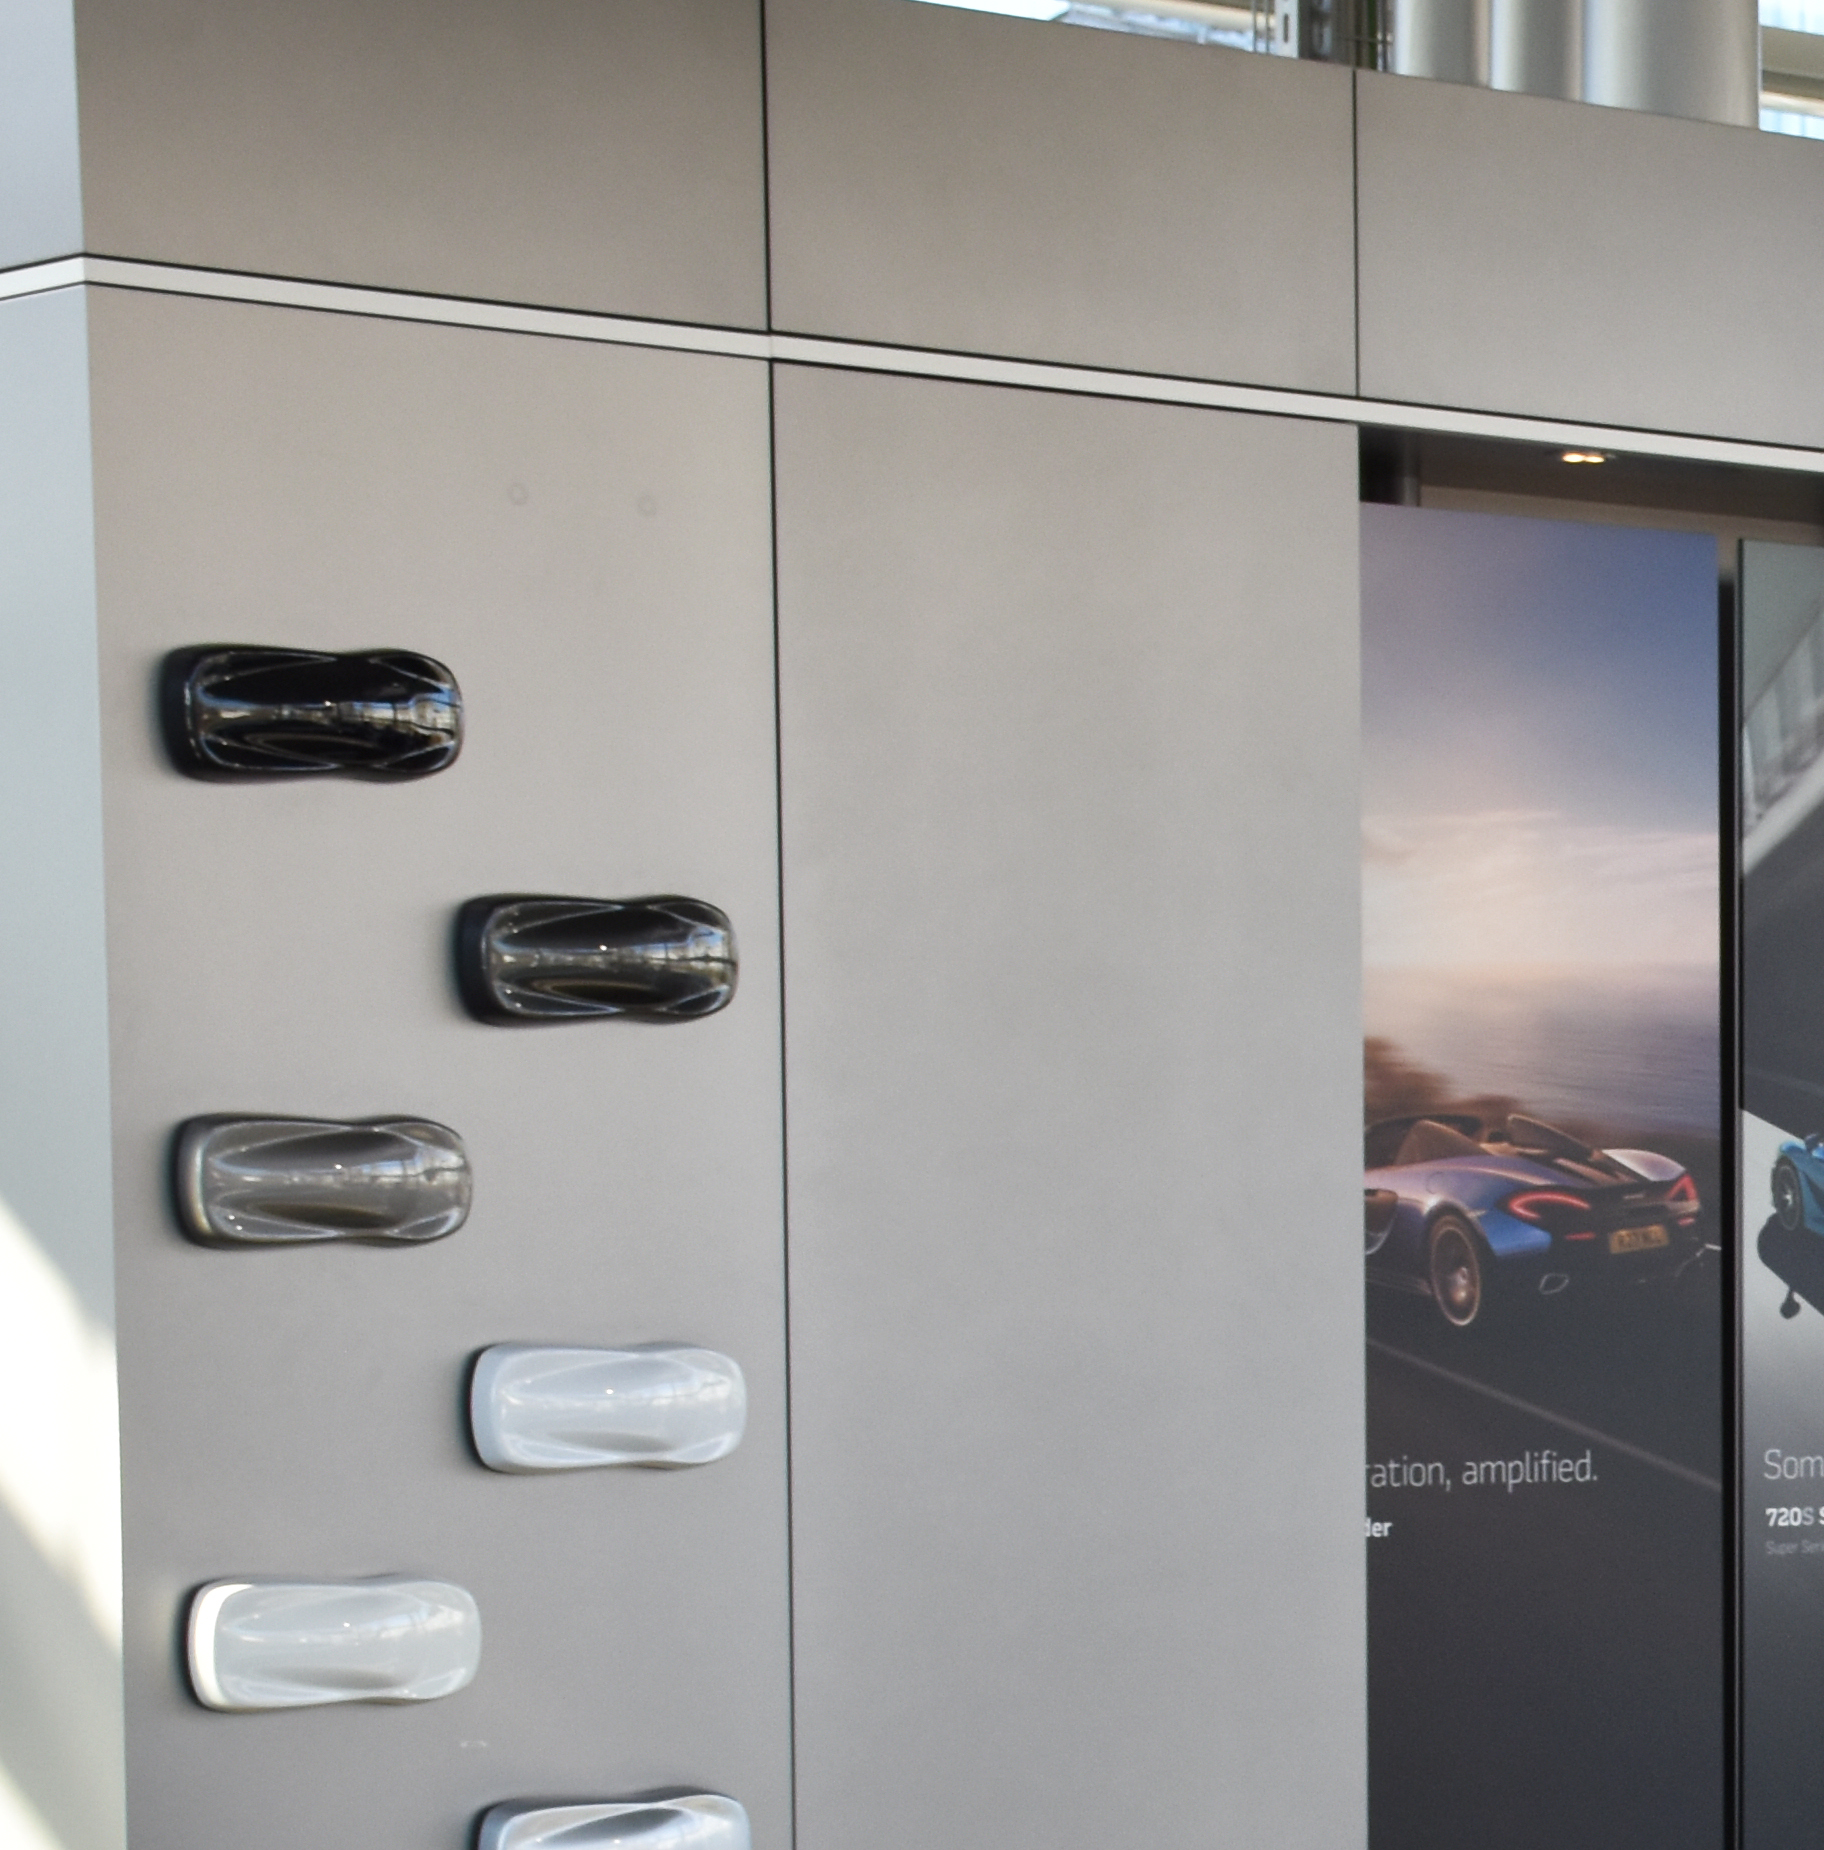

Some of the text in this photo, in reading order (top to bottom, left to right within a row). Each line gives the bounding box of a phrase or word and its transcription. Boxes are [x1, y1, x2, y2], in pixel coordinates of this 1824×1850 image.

[1461, 1450, 1598, 1494] amplified.
[1765, 1507, 1815, 1527] 720S
[1765, 1541, 1798, 1556] Super
